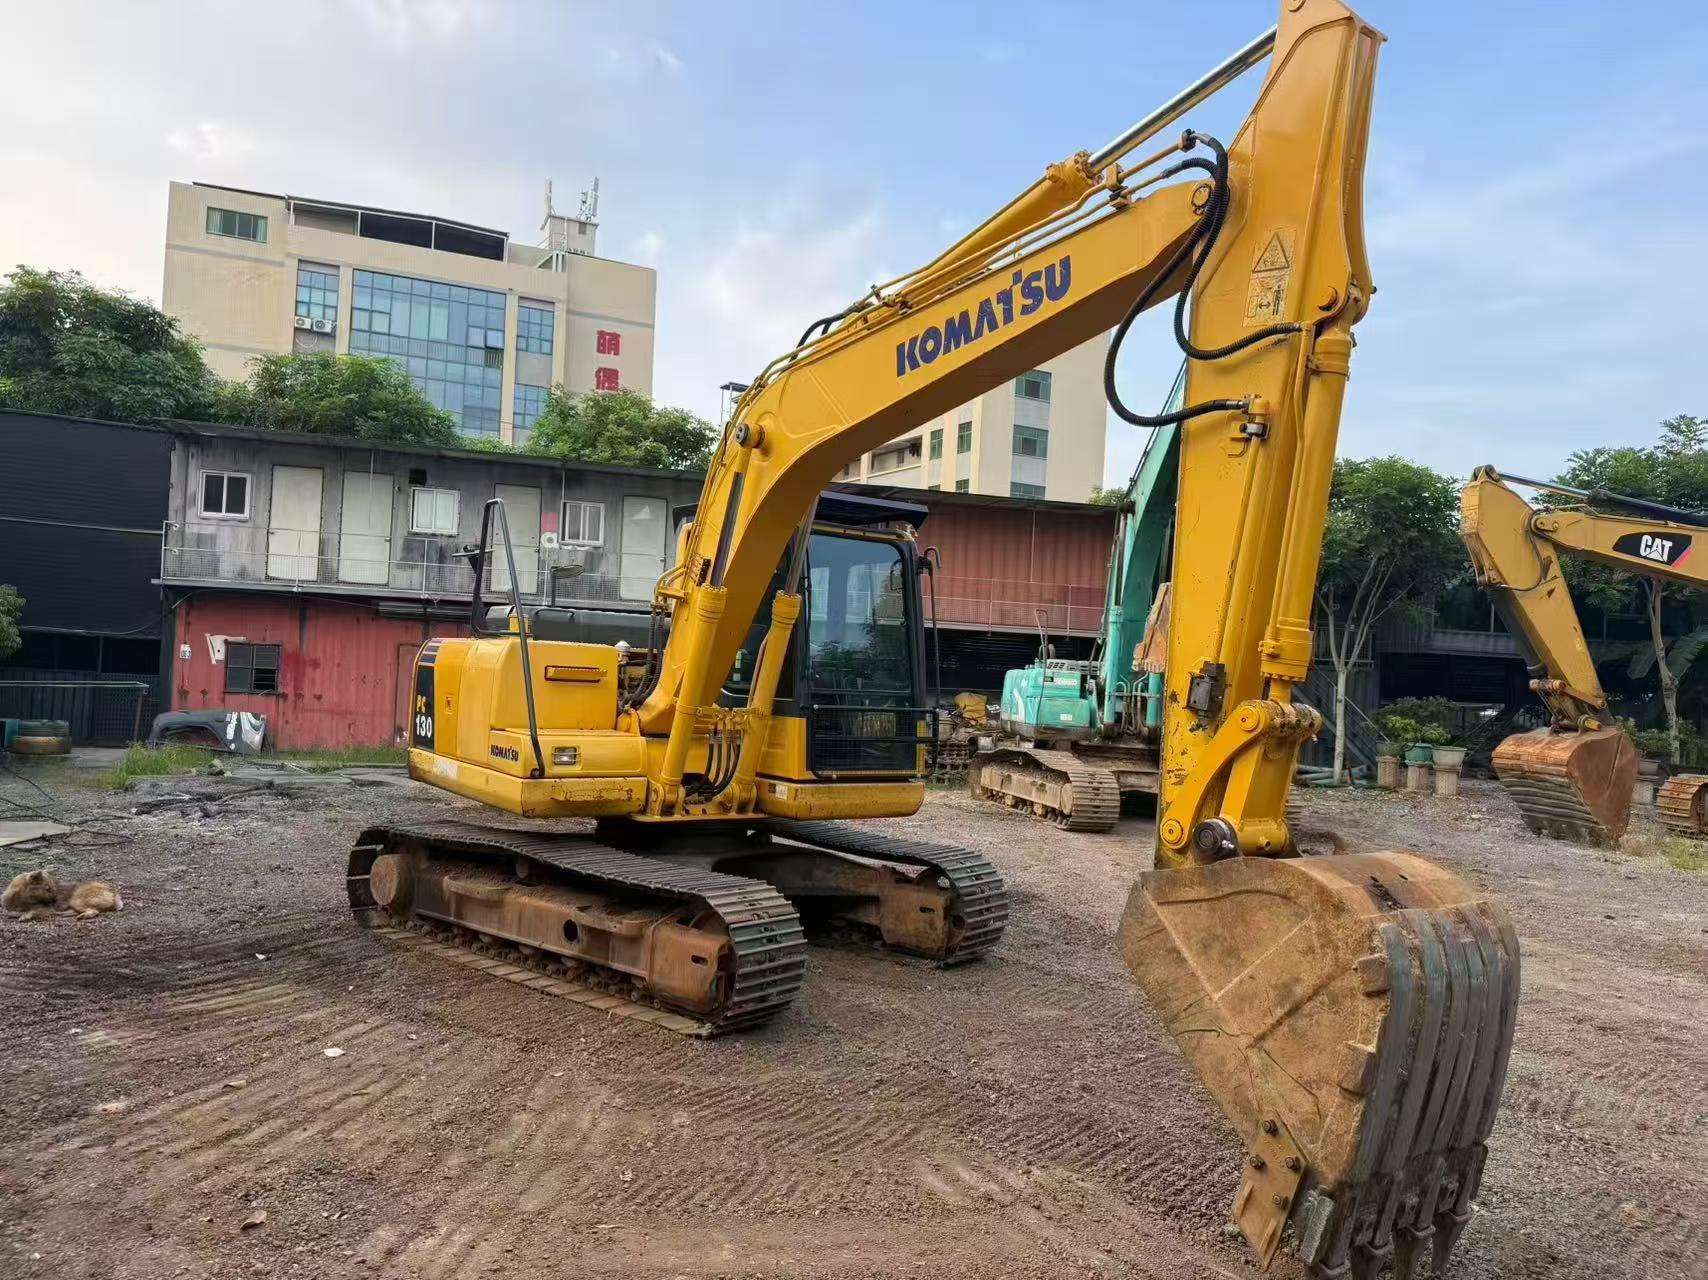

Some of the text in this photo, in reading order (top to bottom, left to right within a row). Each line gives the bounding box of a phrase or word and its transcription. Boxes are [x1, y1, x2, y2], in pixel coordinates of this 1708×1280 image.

[896, 255, 1072, 378] KOMATSU
[1640, 534, 1673, 562] CAT
[415, 714, 433, 739] 130
[490, 744, 519, 762] KOMATSU
